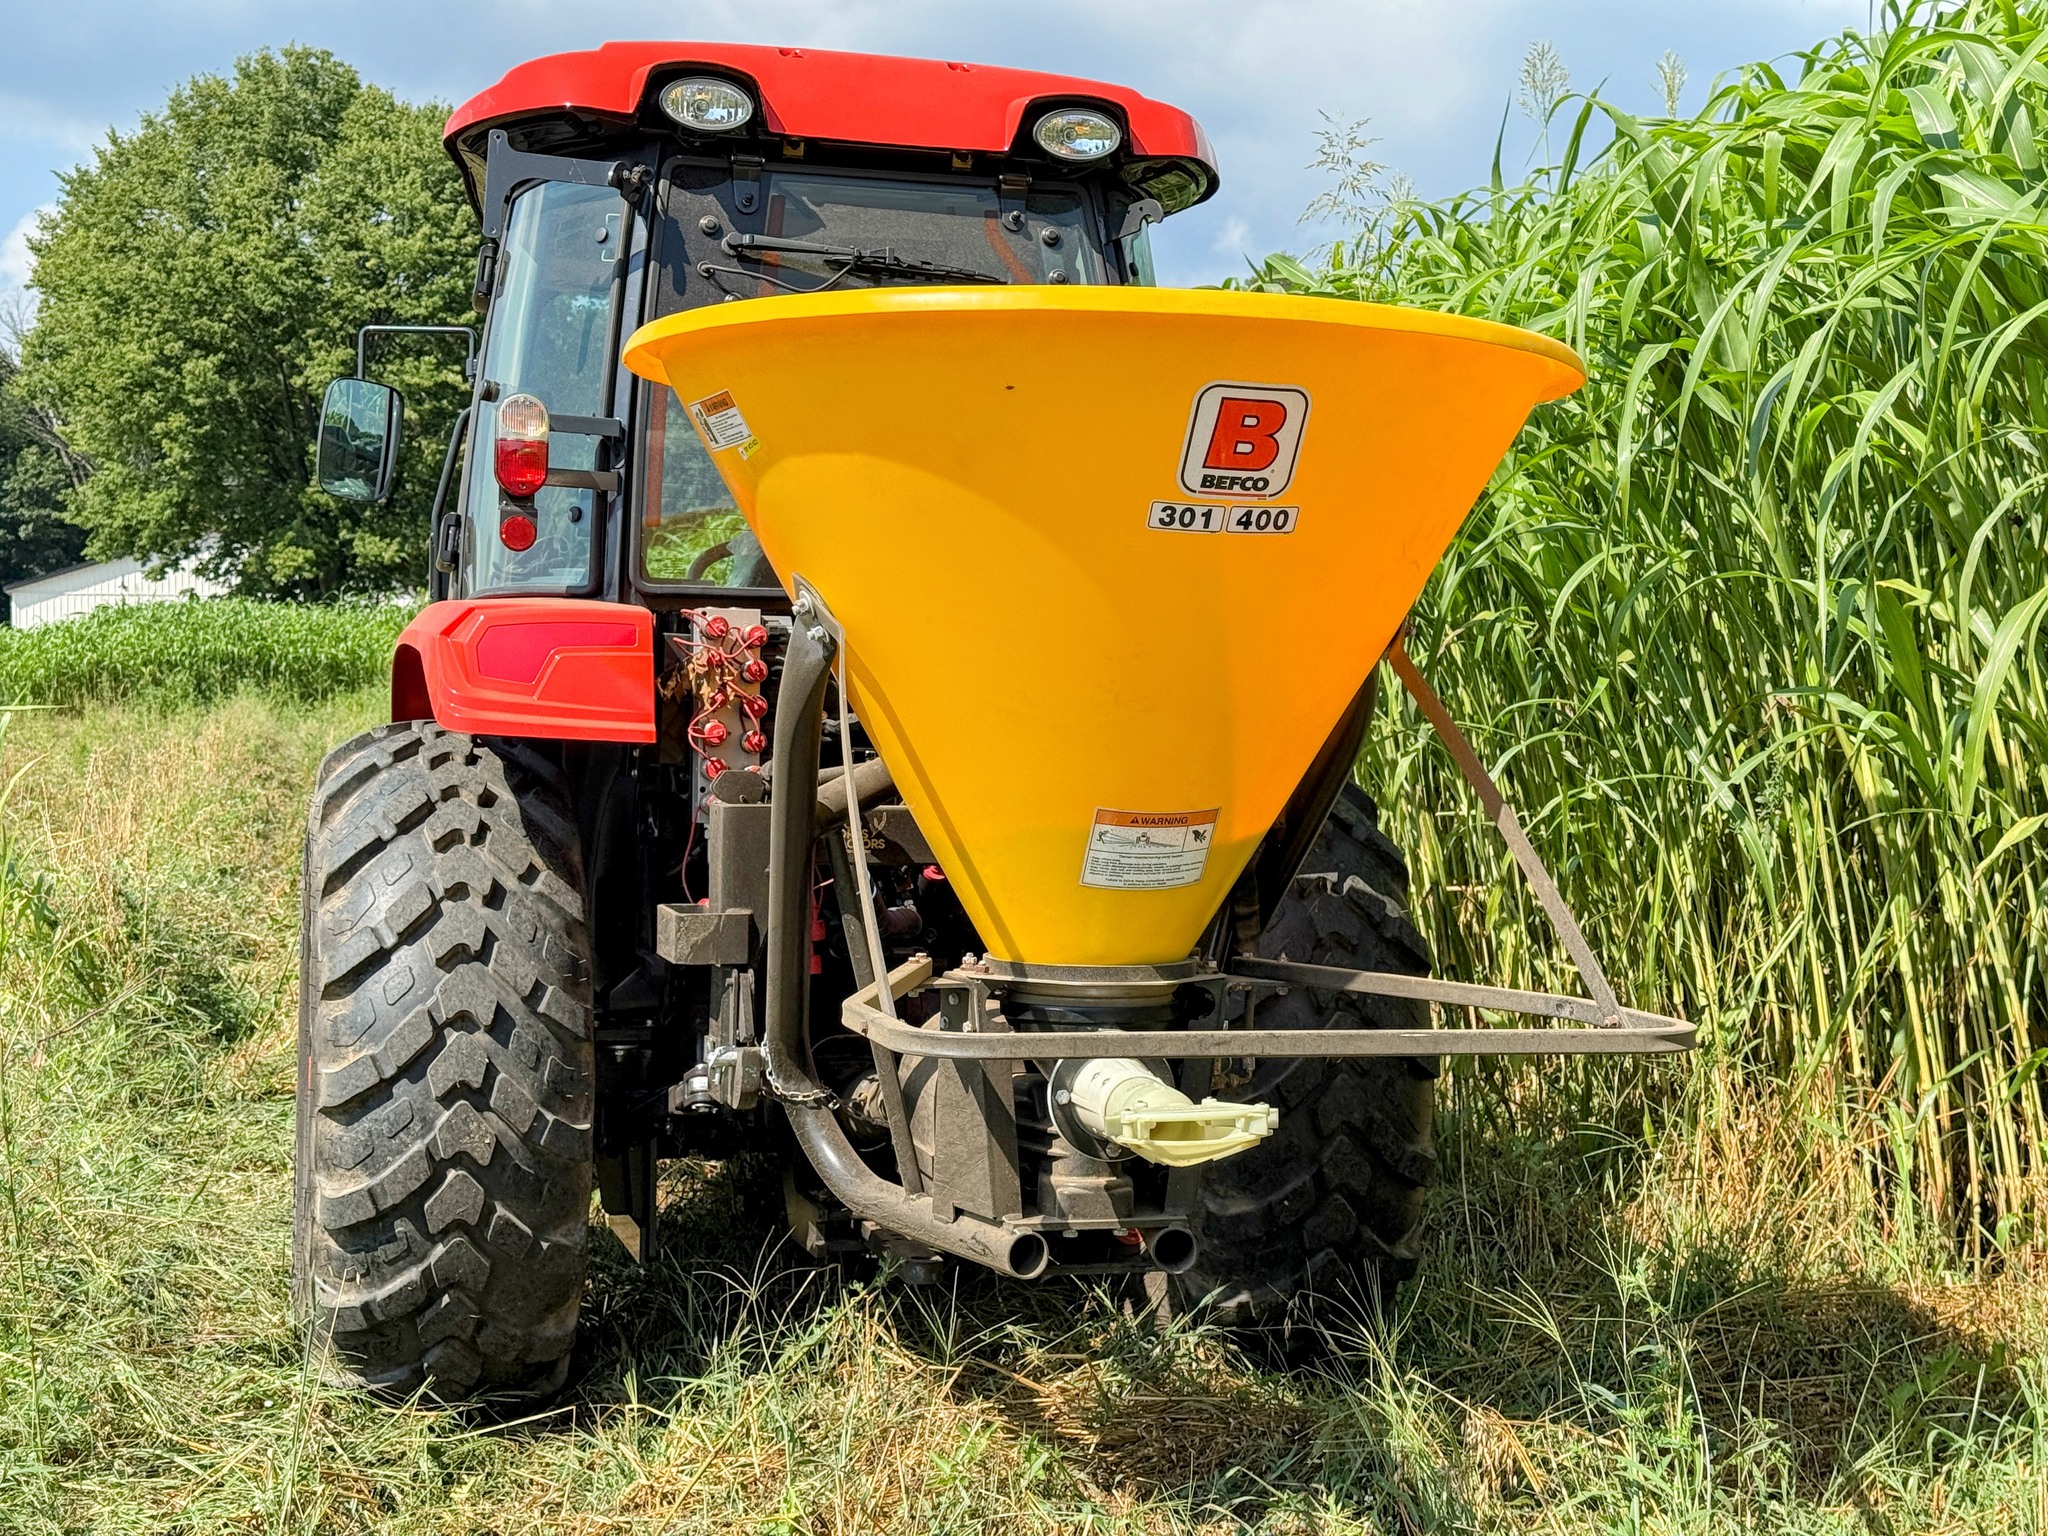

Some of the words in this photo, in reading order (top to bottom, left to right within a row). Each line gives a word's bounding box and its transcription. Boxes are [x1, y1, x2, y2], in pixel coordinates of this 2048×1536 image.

[1202, 396, 1288, 472] B
[1199, 473, 1270, 491] BEFCO
[1158, 505, 1213, 530] 301
[1235, 509, 1290, 531] 400
[1140, 816, 1189, 825] WARNING
